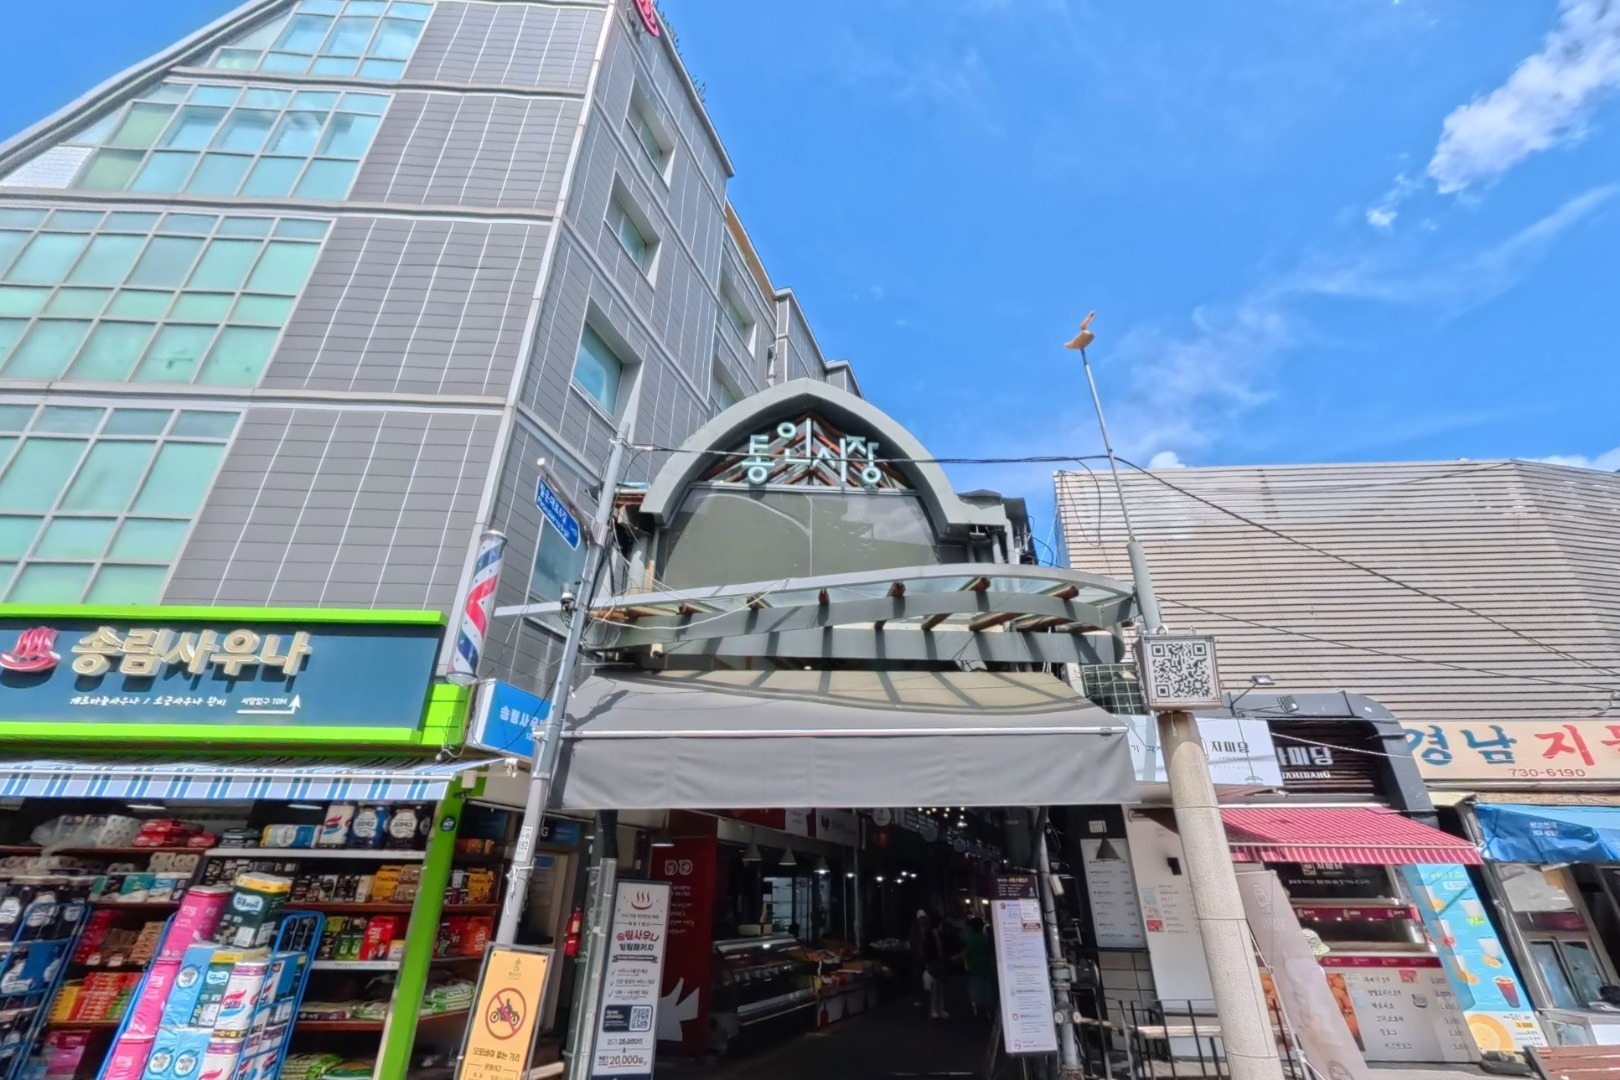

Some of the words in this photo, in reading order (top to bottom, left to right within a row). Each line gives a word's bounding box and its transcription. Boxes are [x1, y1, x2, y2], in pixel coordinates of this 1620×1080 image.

[71, 626, 313, 677] 송림사우나
[500, 705, 541, 732] 송림사우
[1212, 740, 1250, 754] 자미당
[1509, 768, 1586, 778] 730-6190
